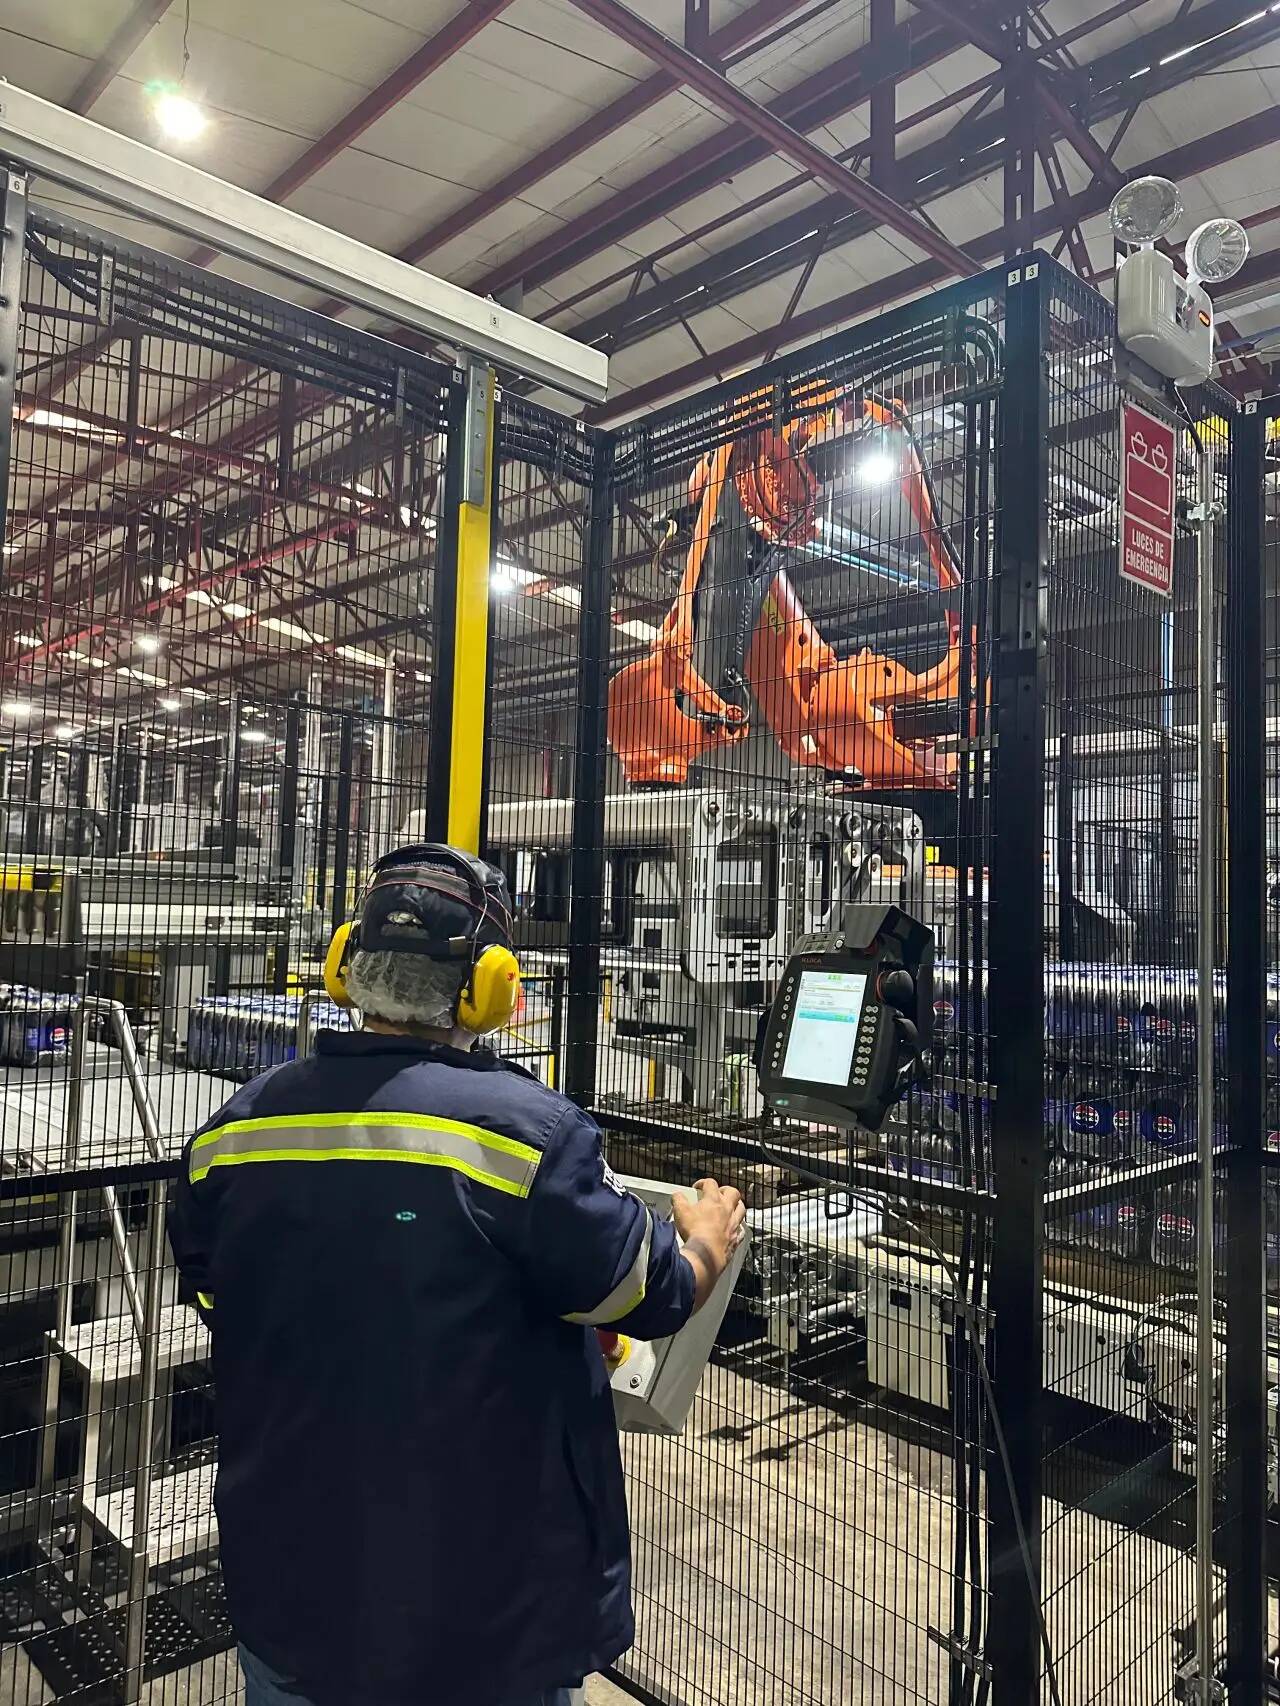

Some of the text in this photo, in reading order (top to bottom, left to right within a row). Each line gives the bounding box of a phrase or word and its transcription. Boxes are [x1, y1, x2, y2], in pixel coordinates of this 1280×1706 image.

[13, 180, 21, 191] 6
[1029, 267, 1035, 277] 3
[1011, 273, 1017, 283] 3
[1131, 527, 1164, 560] LUCES DE
[1125, 547, 1169, 584] EMERGENCIA
